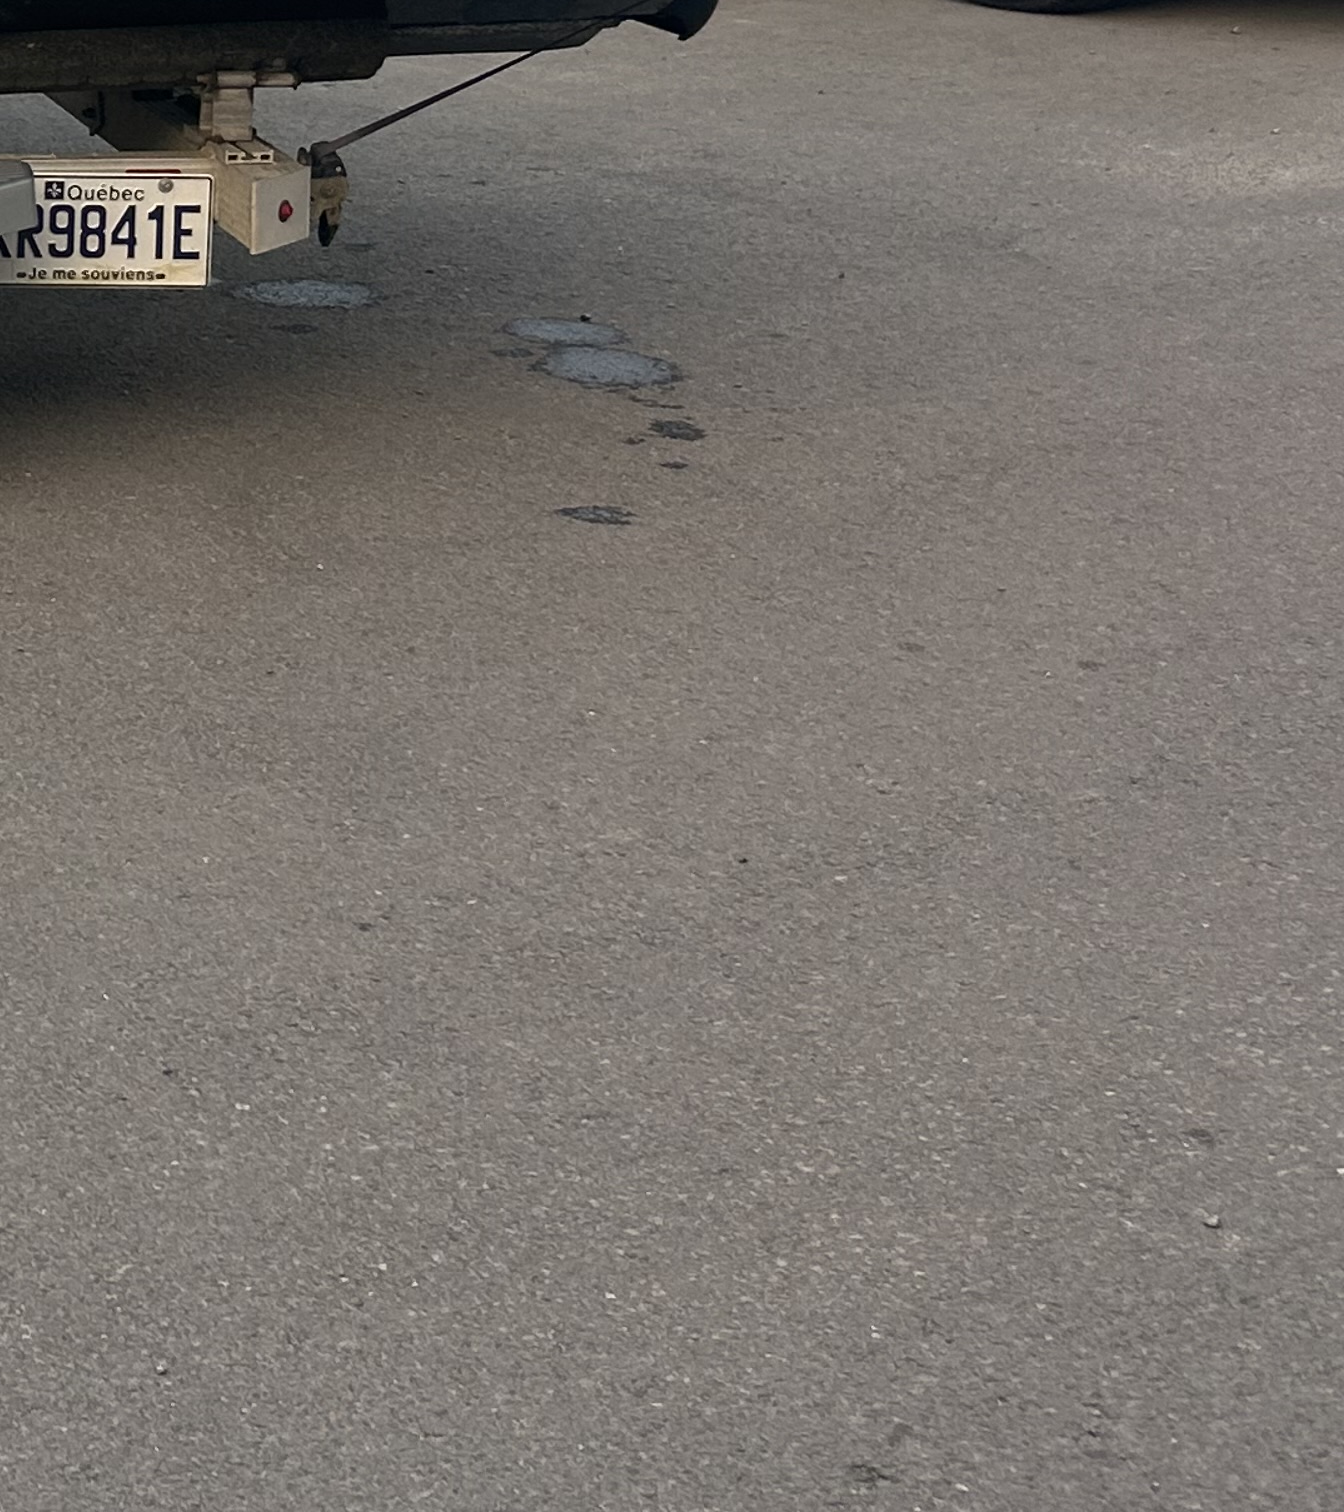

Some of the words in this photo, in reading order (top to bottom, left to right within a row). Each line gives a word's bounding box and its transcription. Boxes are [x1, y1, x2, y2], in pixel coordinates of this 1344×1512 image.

[67, 184, 146, 201] Québec
[28, 267, 47, 280] Je
[53, 271, 77, 280] me
[82, 267, 155, 280] souviens
